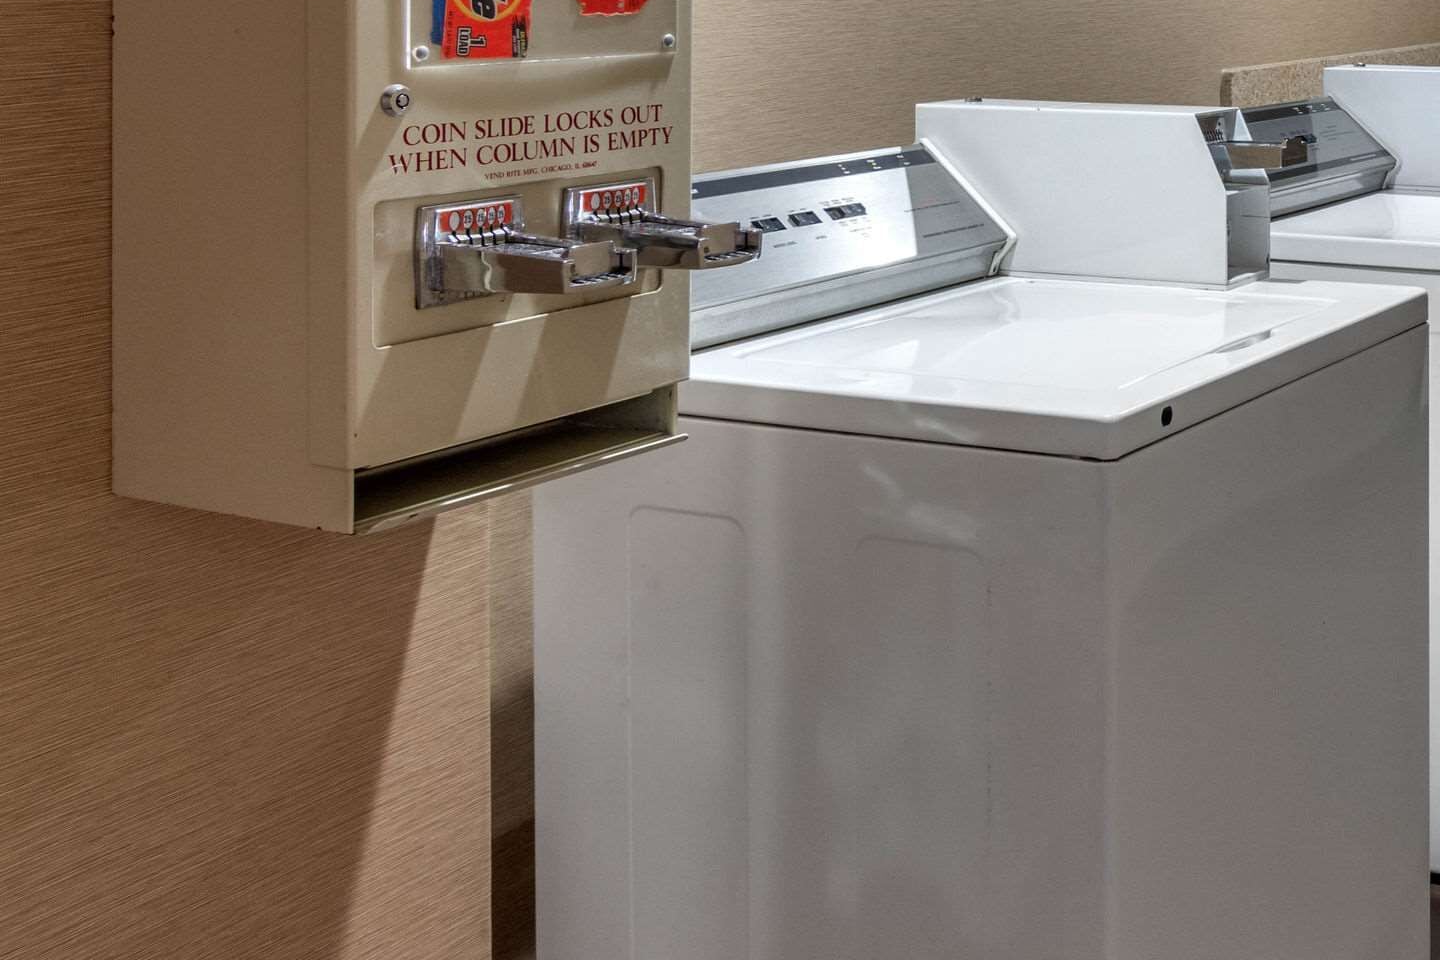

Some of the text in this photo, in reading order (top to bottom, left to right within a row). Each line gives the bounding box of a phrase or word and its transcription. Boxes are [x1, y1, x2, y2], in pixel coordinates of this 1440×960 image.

[457, 26, 472, 56] LOAD
[469, 35, 487, 47] 1
[403, 104, 664, 146] COIN SLIDE LOCKS OUT
[389, 126, 674, 175] WHEN COLUMN IS EMPTY
[484, 171, 505, 180] VEND
